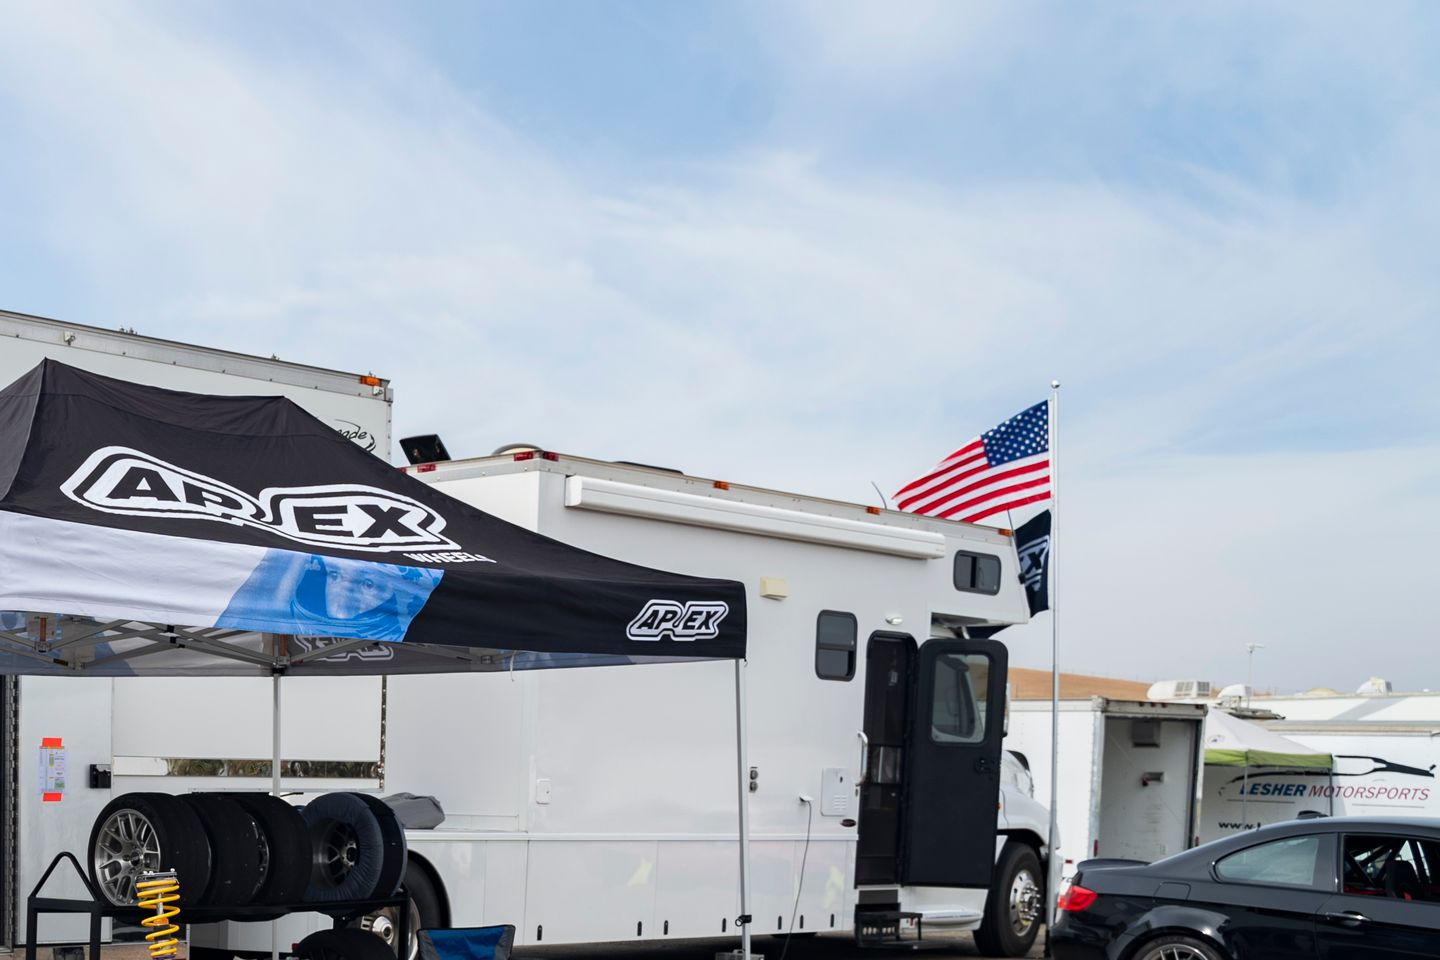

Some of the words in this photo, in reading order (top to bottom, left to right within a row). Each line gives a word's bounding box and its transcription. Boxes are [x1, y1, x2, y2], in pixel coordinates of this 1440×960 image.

[84, 456, 437, 546] APEX
[631, 604, 723, 636] APEX
[1240, 783, 1307, 797] LESHER
[1309, 785, 1431, 801] MOTORSPORTS
